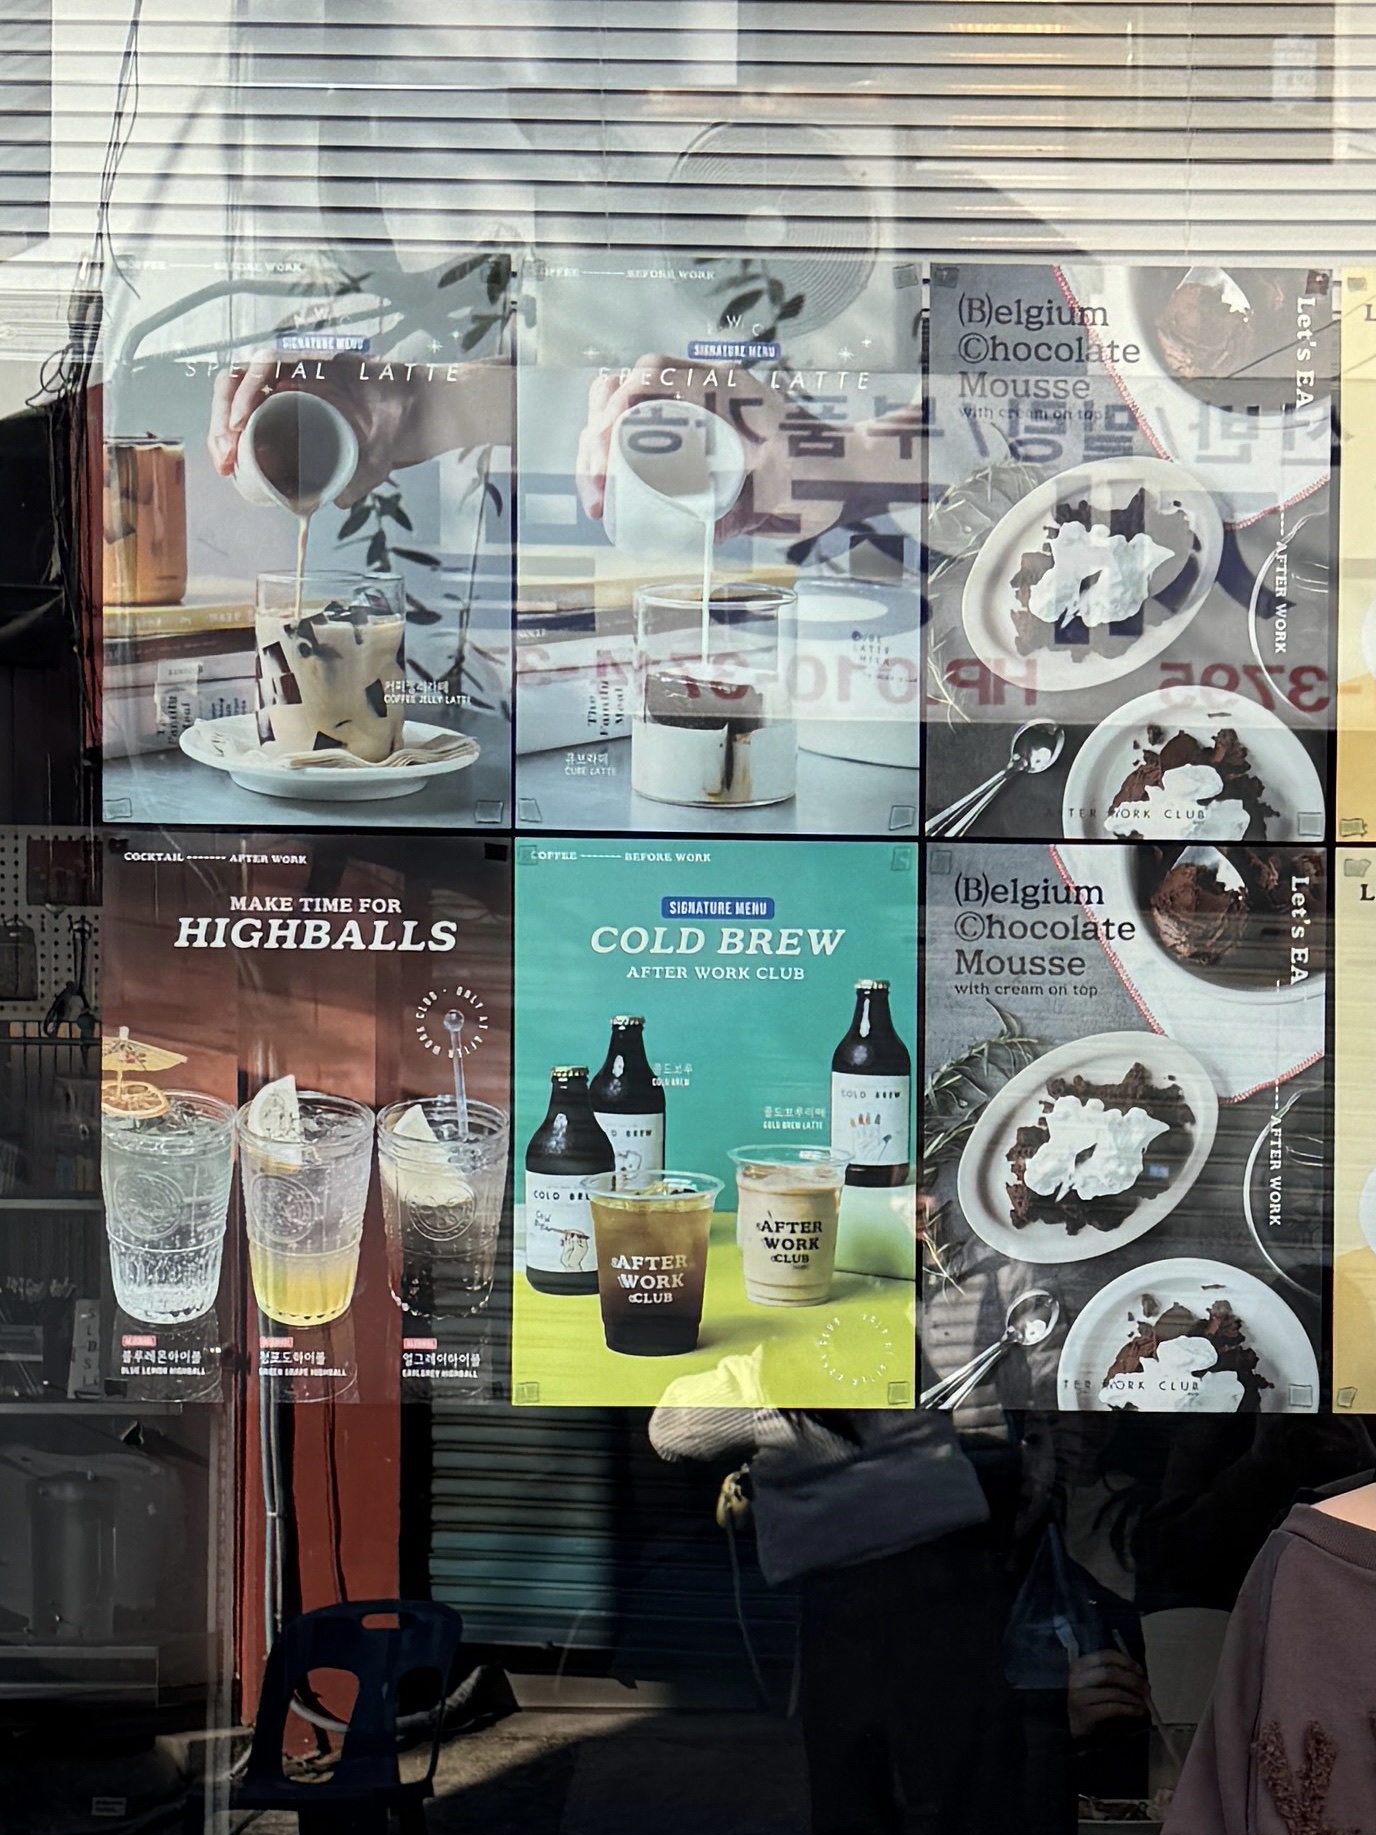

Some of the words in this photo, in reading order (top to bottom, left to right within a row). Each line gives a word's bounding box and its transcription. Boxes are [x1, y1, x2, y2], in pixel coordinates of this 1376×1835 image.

[958, 292, 1109, 331] (B)elgium
[1296, 297, 1316, 360] Let's
[359, 362, 459, 382] LATTE
[770, 370, 870, 390] LATTE
[958, 371, 1090, 398] Mousse
[1295, 369, 1315, 410] EA
[1275, 542, 1287, 597] AFTER
[1275, 603, 1287, 654] WORK
[1164, 808, 1205, 820] CLUB
[124, 852, 184, 863] COCKTAIL
[229, 853, 269, 864] AFTER
[271, 853, 307, 865] WORK
[625, 852, 672, 863] BEFORE
[676, 852, 711, 863] WORK
[955, 871, 1104, 910] (B)elgium
[230, 896, 293, 913] MAKE
[299, 896, 352, 913] TIME
[358, 897, 402, 914] FOR
[669, 901, 732, 915] SIGNATURE
[735, 901, 767, 915] MENU
[1291, 876, 1310, 939] Let's
[173, 917, 457, 952] HIGHBALLS
[590, 926, 705, 955] COLD
[717, 927, 845, 956] BREW
[956, 949, 1086, 976] Mousse
[1290, 947, 1309, 988] EA
[626, 966, 687, 979] AFTER
[695, 966, 750, 979] WORK
[756, 966, 805, 980] CLUB
[955, 982, 990, 996] with
[995, 985, 1043, 996] cream
[1048, 985, 1068, 996] on
[1073, 983, 1098, 998] top
[1270, 1115, 1282, 1170] AFTER
[533, 1190, 560, 1200] COLD
[1269, 1176, 1282, 1226] WORK
[757, 1220, 823, 1234] AFTER
[762, 1237, 820, 1251] WORK
[611, 1255, 688, 1270] AFTER
[771, 1253, 809, 1264] CLUB
[618, 1273, 684, 1290] WORK
[628, 1293, 673, 1304] CLUB
[1159, 1380, 1199, 1391] CLUB
